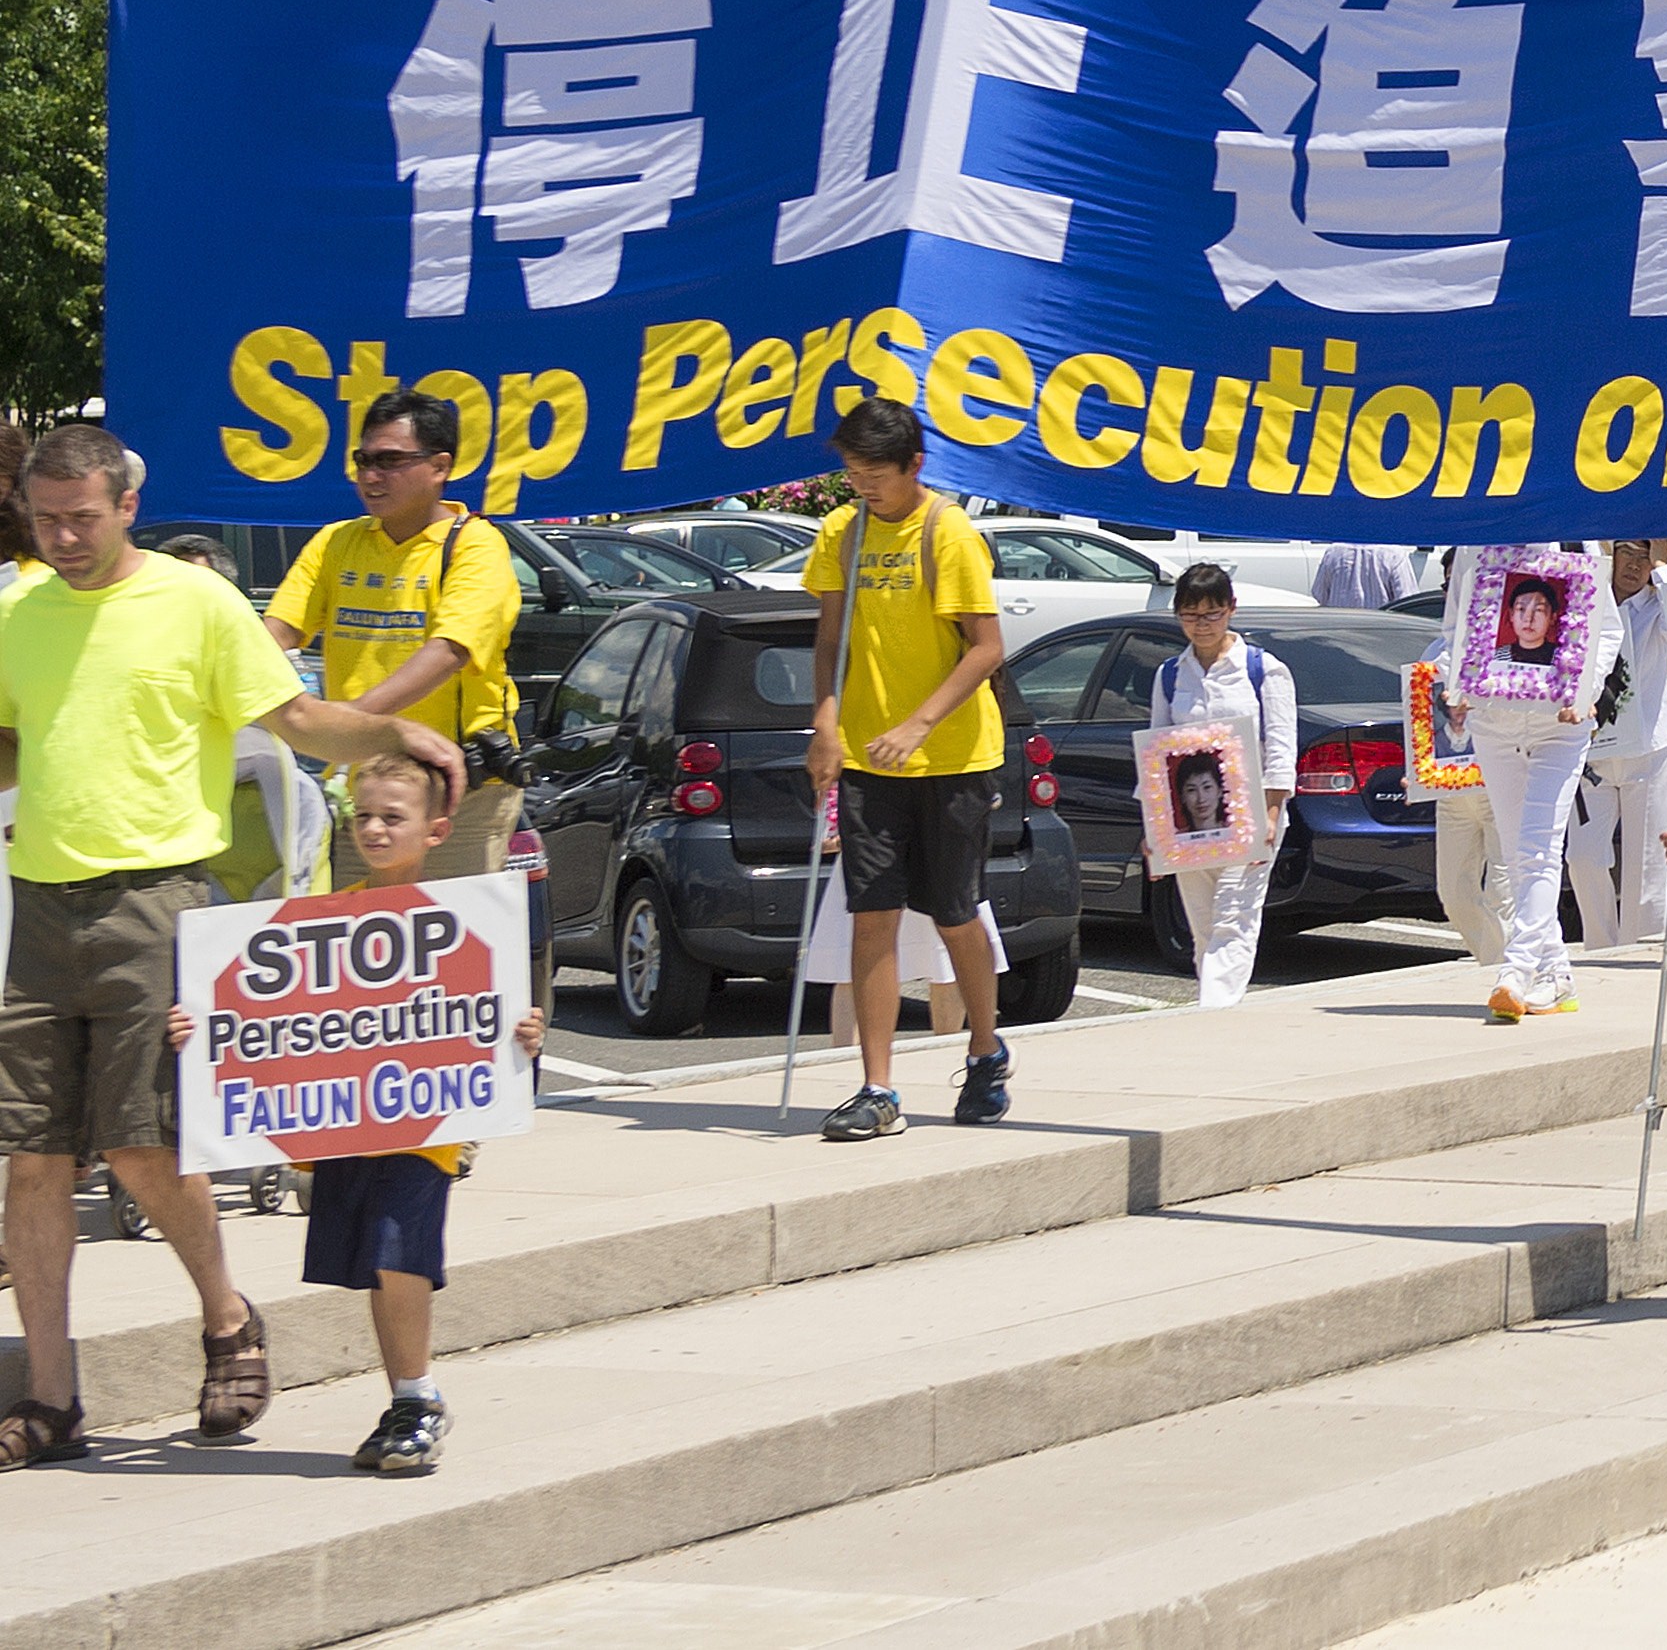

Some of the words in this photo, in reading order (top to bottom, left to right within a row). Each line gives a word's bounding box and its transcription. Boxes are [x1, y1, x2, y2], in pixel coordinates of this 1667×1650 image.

[220, 326, 588, 515] Stop
[622, 307, 1536, 487] Persecution
[244, 909, 459, 996] STOP
[207, 990, 502, 1063] Persecuting
